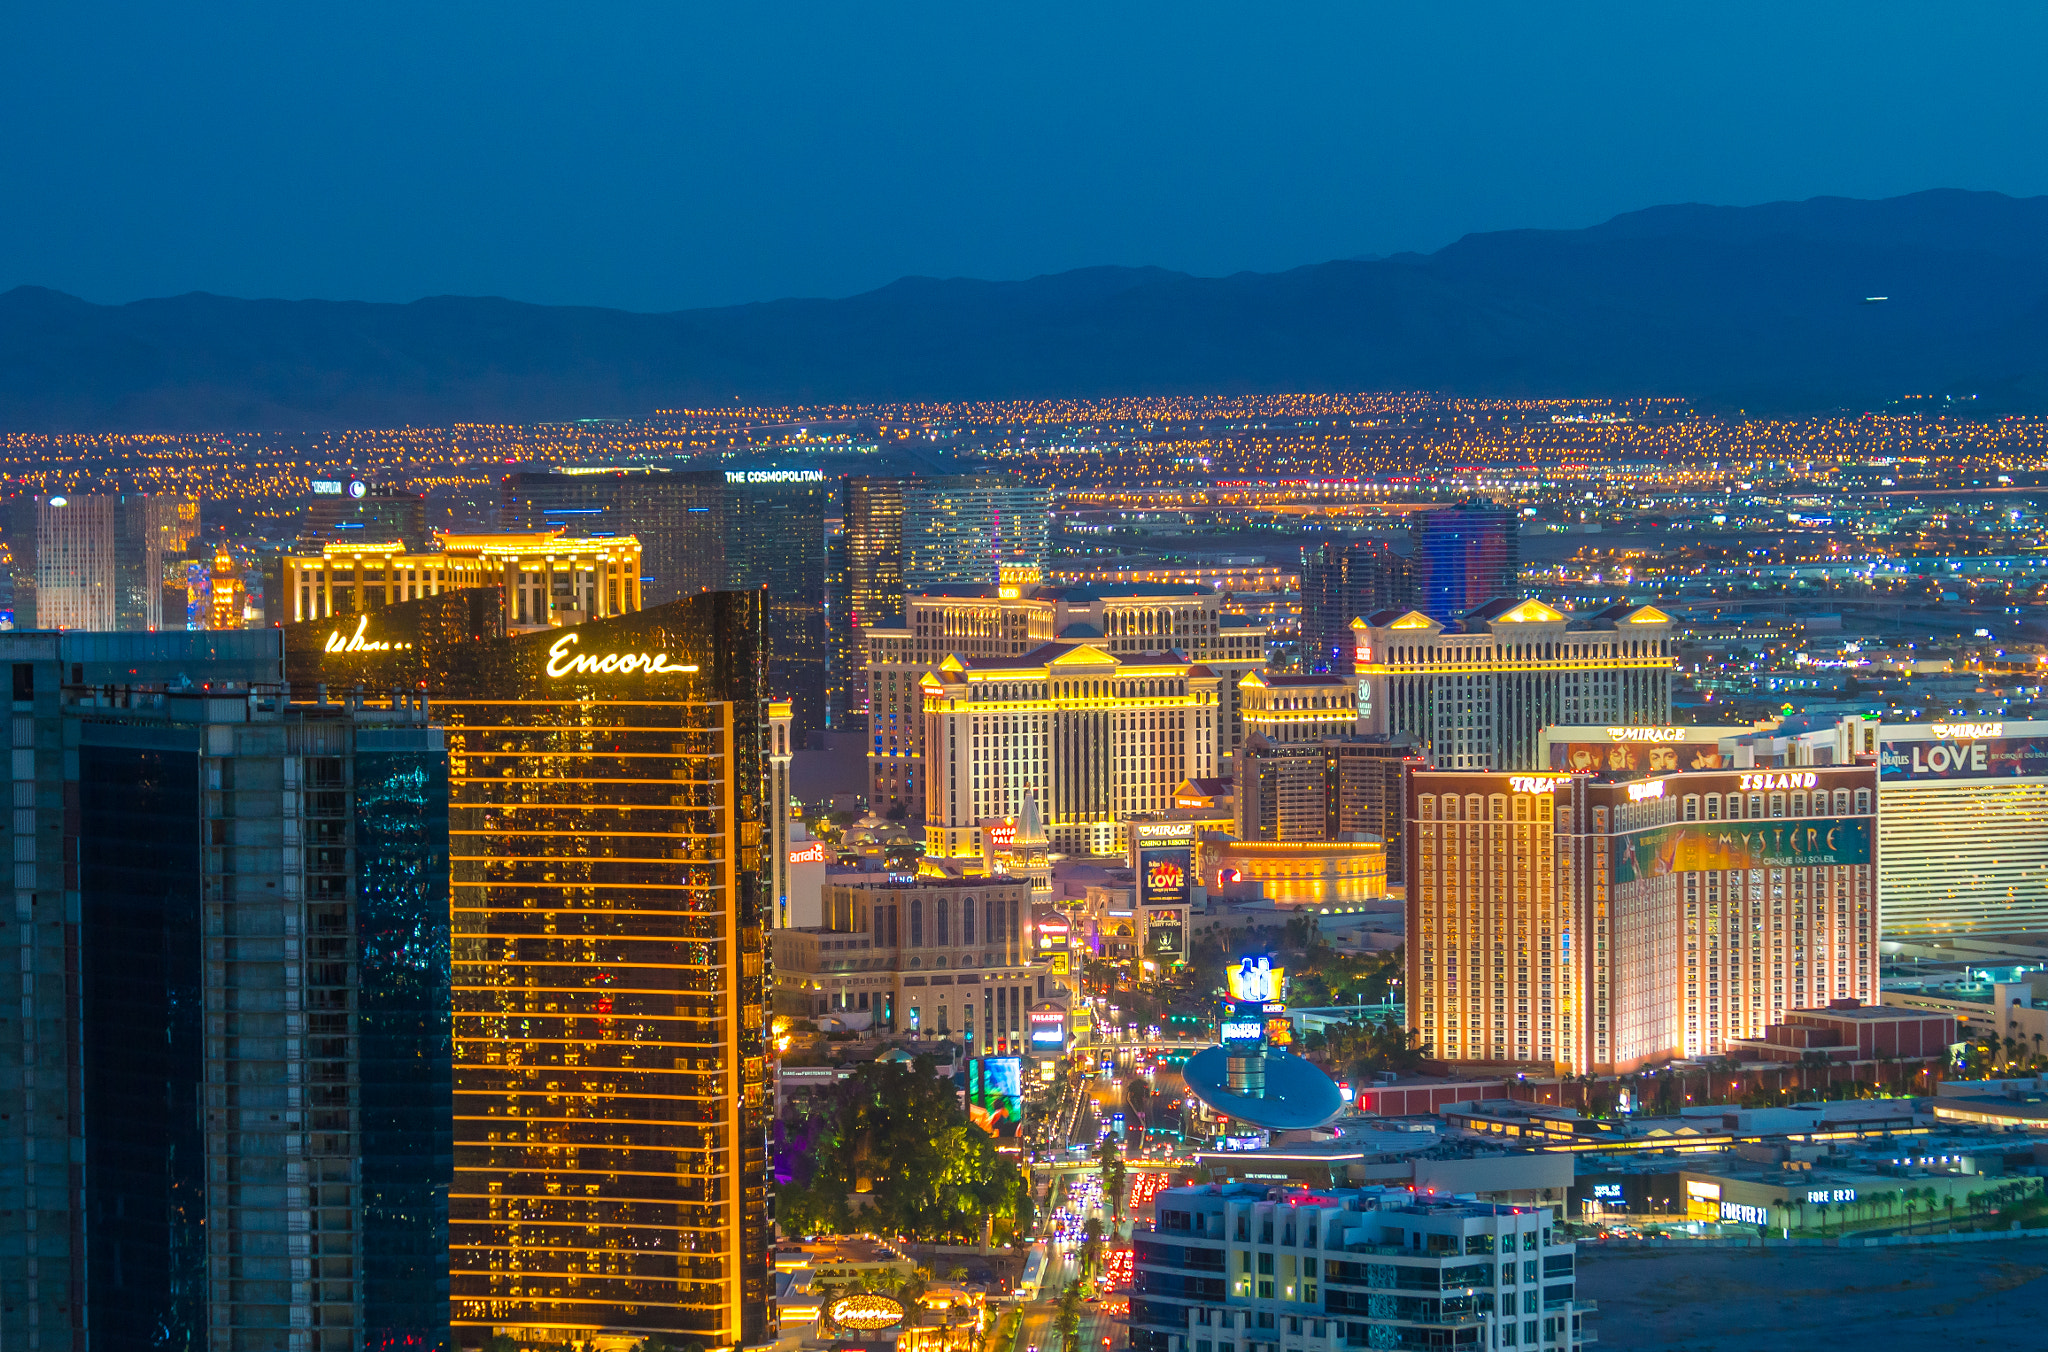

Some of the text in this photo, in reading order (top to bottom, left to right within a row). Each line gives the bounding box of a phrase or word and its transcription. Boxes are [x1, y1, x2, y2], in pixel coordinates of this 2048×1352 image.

[725, 470, 823, 483] THE COSMOPOLITAN
[546, 632, 699, 678] Encore
[1612, 727, 1686, 743] MIRAGE
[1937, 722, 2003, 740] MIRAGE
[1913, 745, 1987, 773] LOVE
[1739, 772, 1818, 790] ISLAND
[1142, 824, 1192, 837] MIRAGE
[1763, 857, 1793, 867] CIRQUE
[1809, 855, 1837, 864] SOLEIL
[1147, 873, 1184, 888] LOVE
[1230, 1030, 1260, 1039] SHOW
[1808, 1189, 1844, 1203] FOREER
[1757, 1207, 1767, 1225] 21
[833, 1301, 903, 1320] Encore
